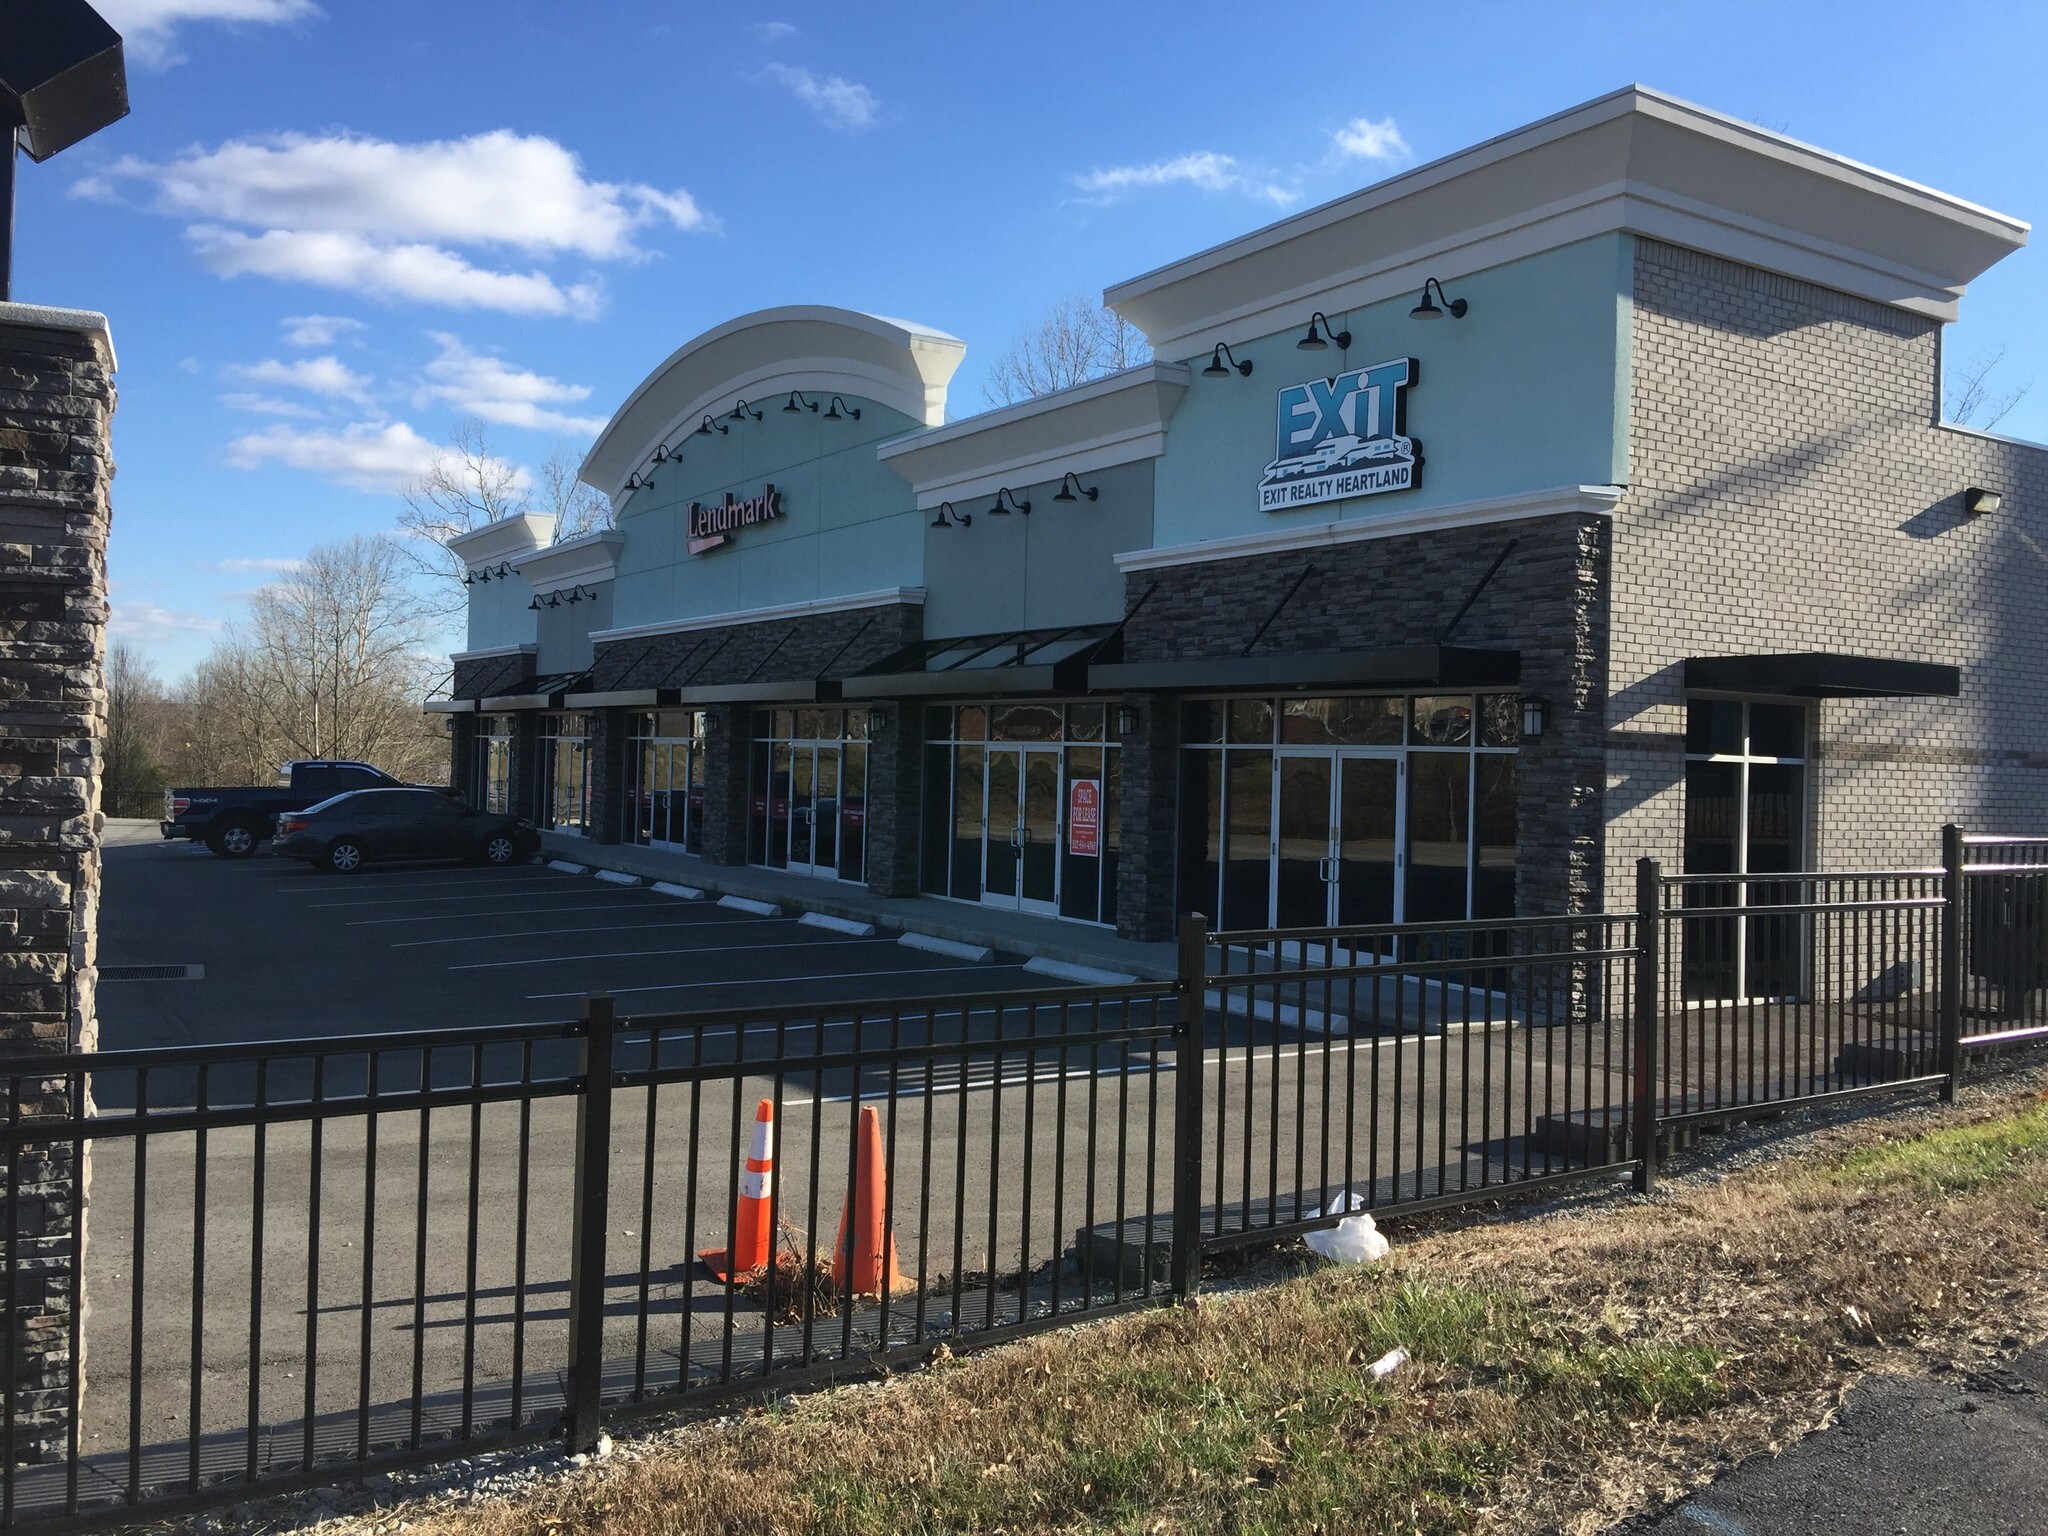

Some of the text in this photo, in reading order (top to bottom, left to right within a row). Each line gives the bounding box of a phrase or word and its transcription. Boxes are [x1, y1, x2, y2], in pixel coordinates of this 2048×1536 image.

[1263, 467, 1409, 506] EXIT REALTY HEARTLAND
[687, 484, 777, 538] Lendmark
[1077, 789, 1092, 804] SPACE
[1073, 806, 1096, 822] FOR LEASE
